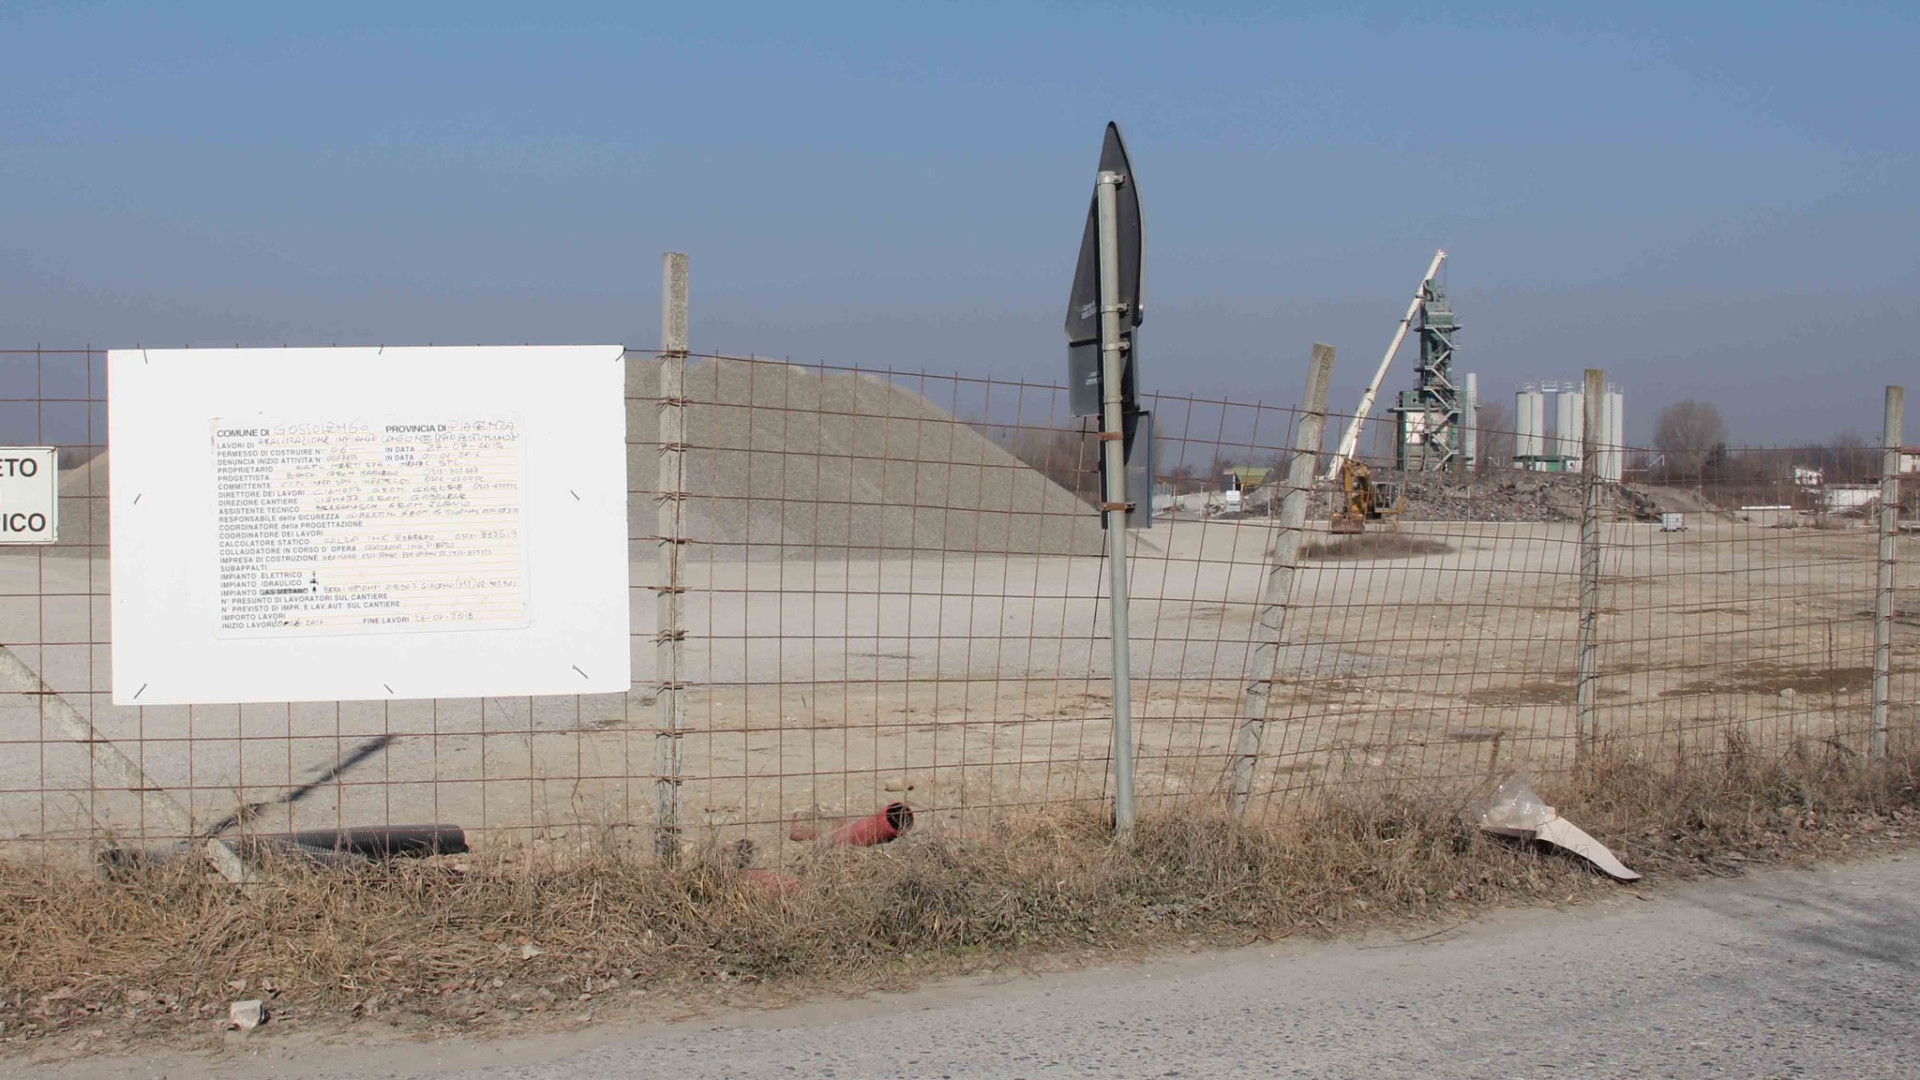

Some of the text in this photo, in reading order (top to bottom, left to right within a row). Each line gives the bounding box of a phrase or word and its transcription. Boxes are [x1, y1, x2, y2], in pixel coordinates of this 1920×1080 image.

[385, 424, 446, 433] PROVINCIA DI
[216, 428, 269, 438] COMUNE DI
[216, 442, 245, 450] LAVORI
[269, 448, 313, 456] COSTRUIRE
[217, 458, 255, 466] DENUNCIA
[0, 458, 38, 477] TO
[217, 466, 274, 474] PROPRIETARIO
[217, 474, 270, 482] PROGETTISTA
[217, 482, 271, 490] COMMITTENTE
[218, 490, 260, 498] DIRETTORE
[218, 506, 300, 515] ASSISTENTE TECNICO
[218, 515, 277, 523] RESPONSABILE
[298, 513, 340, 521] SICUREZZA
[0, 512, 46, 533] ICO
[218, 520, 363, 531] COORDINATORE della PROGETTAZIONE
[219, 531, 280, 539] COORDINATORE
[219, 538, 310, 547] CALCOLATORE STATICO
[219, 547, 281, 556] COLLAUDATORE
[292, 546, 320, 554] CORSO
[220, 556, 253, 564] IMPRESA
[265, 554, 319, 563] COSTRUZIONE
[220, 564, 268, 572] SUBAPPALTI
[261, 571, 303, 579] ELETTRICO
[260, 579, 302, 587] IDRAULICO
[220, 589, 257, 597] IMPIANTO
[231, 596, 273, 605] PRESUNTO
[283, 594, 333, 603] LAVORATORI
[334, 594, 349, 602] SUL
[350, 592, 388, 601] CANTIERE
[231, 605, 269, 613] PREVISTO
[363, 600, 401, 608] CANTIERE
[221, 613, 256, 621] IMPORTO
